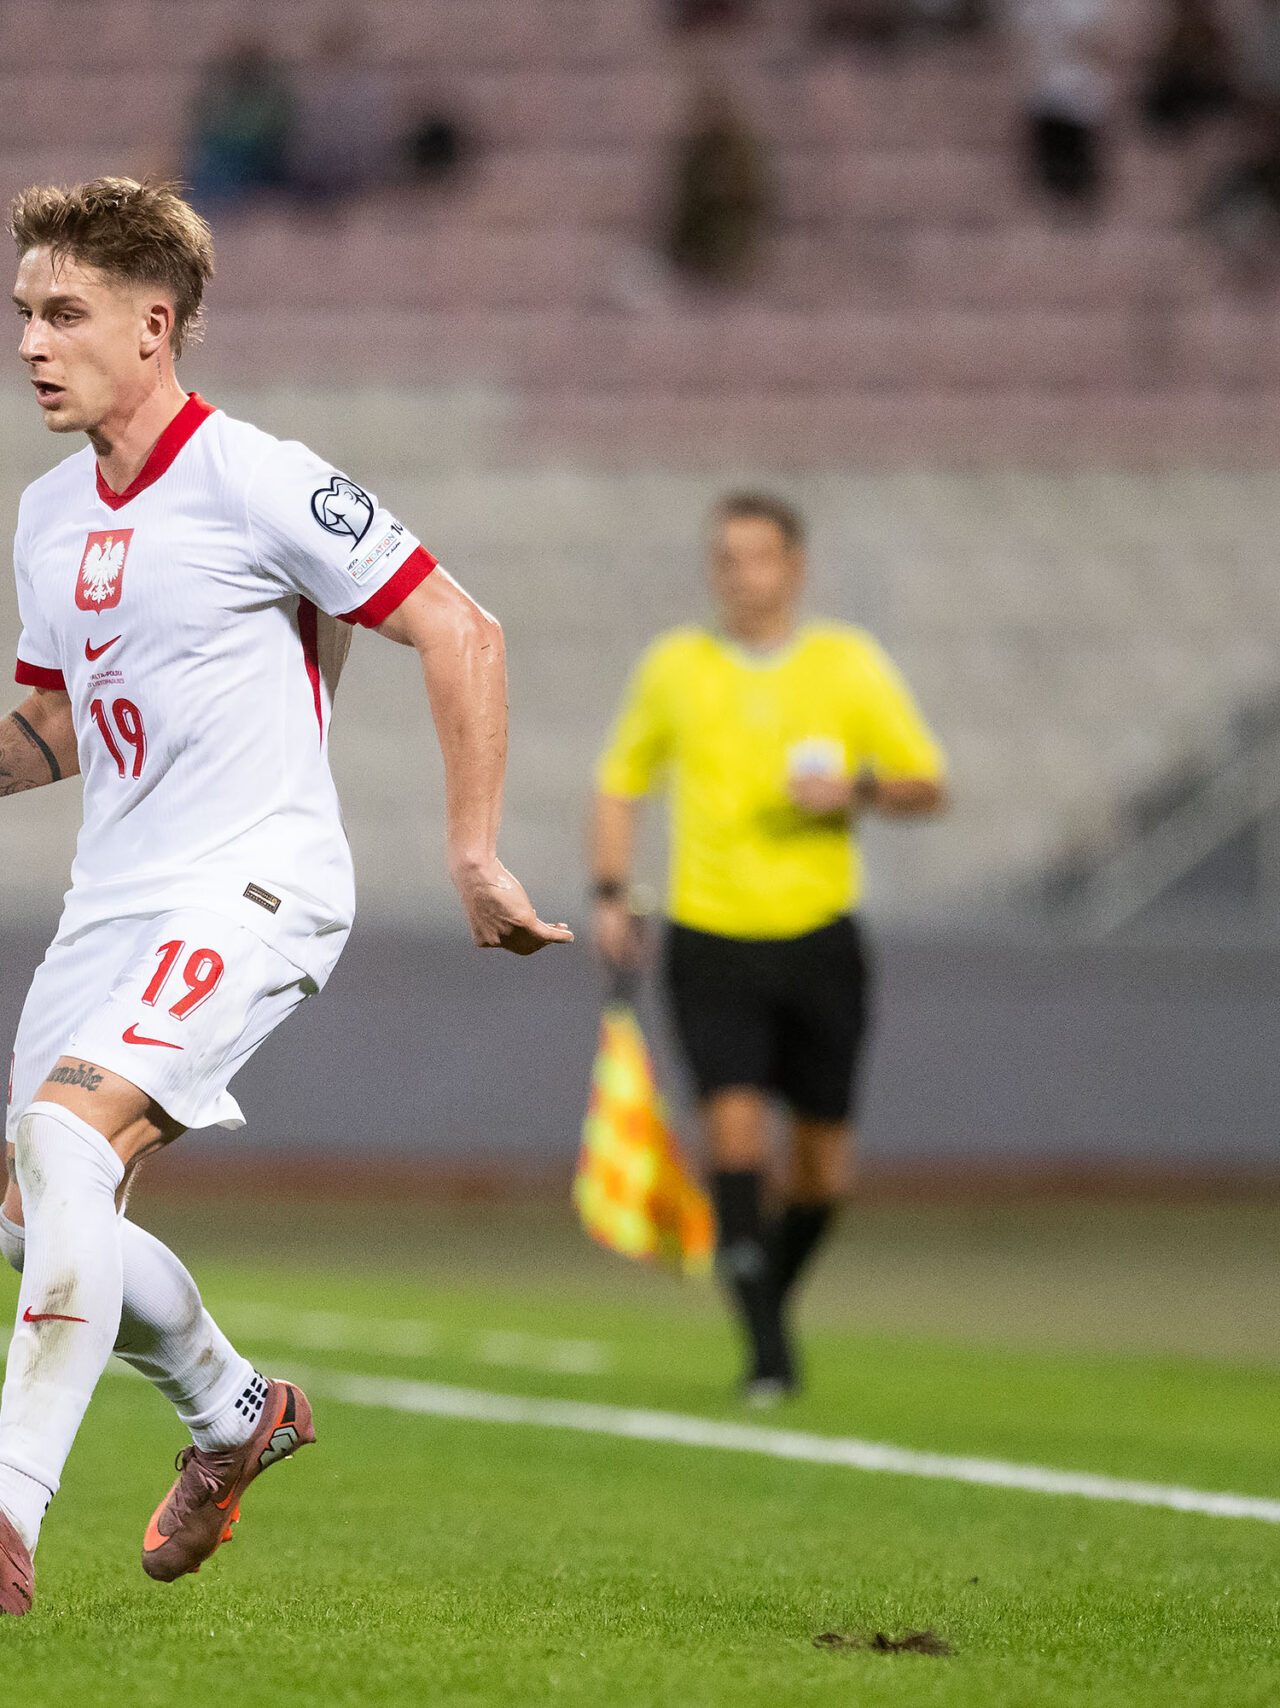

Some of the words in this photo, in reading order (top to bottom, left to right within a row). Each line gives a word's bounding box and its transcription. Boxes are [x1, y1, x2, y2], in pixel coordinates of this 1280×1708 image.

[352, 533, 396, 579] FOUNDATION
[90, 697, 148, 780] 19
[141, 940, 224, 1021] 19
